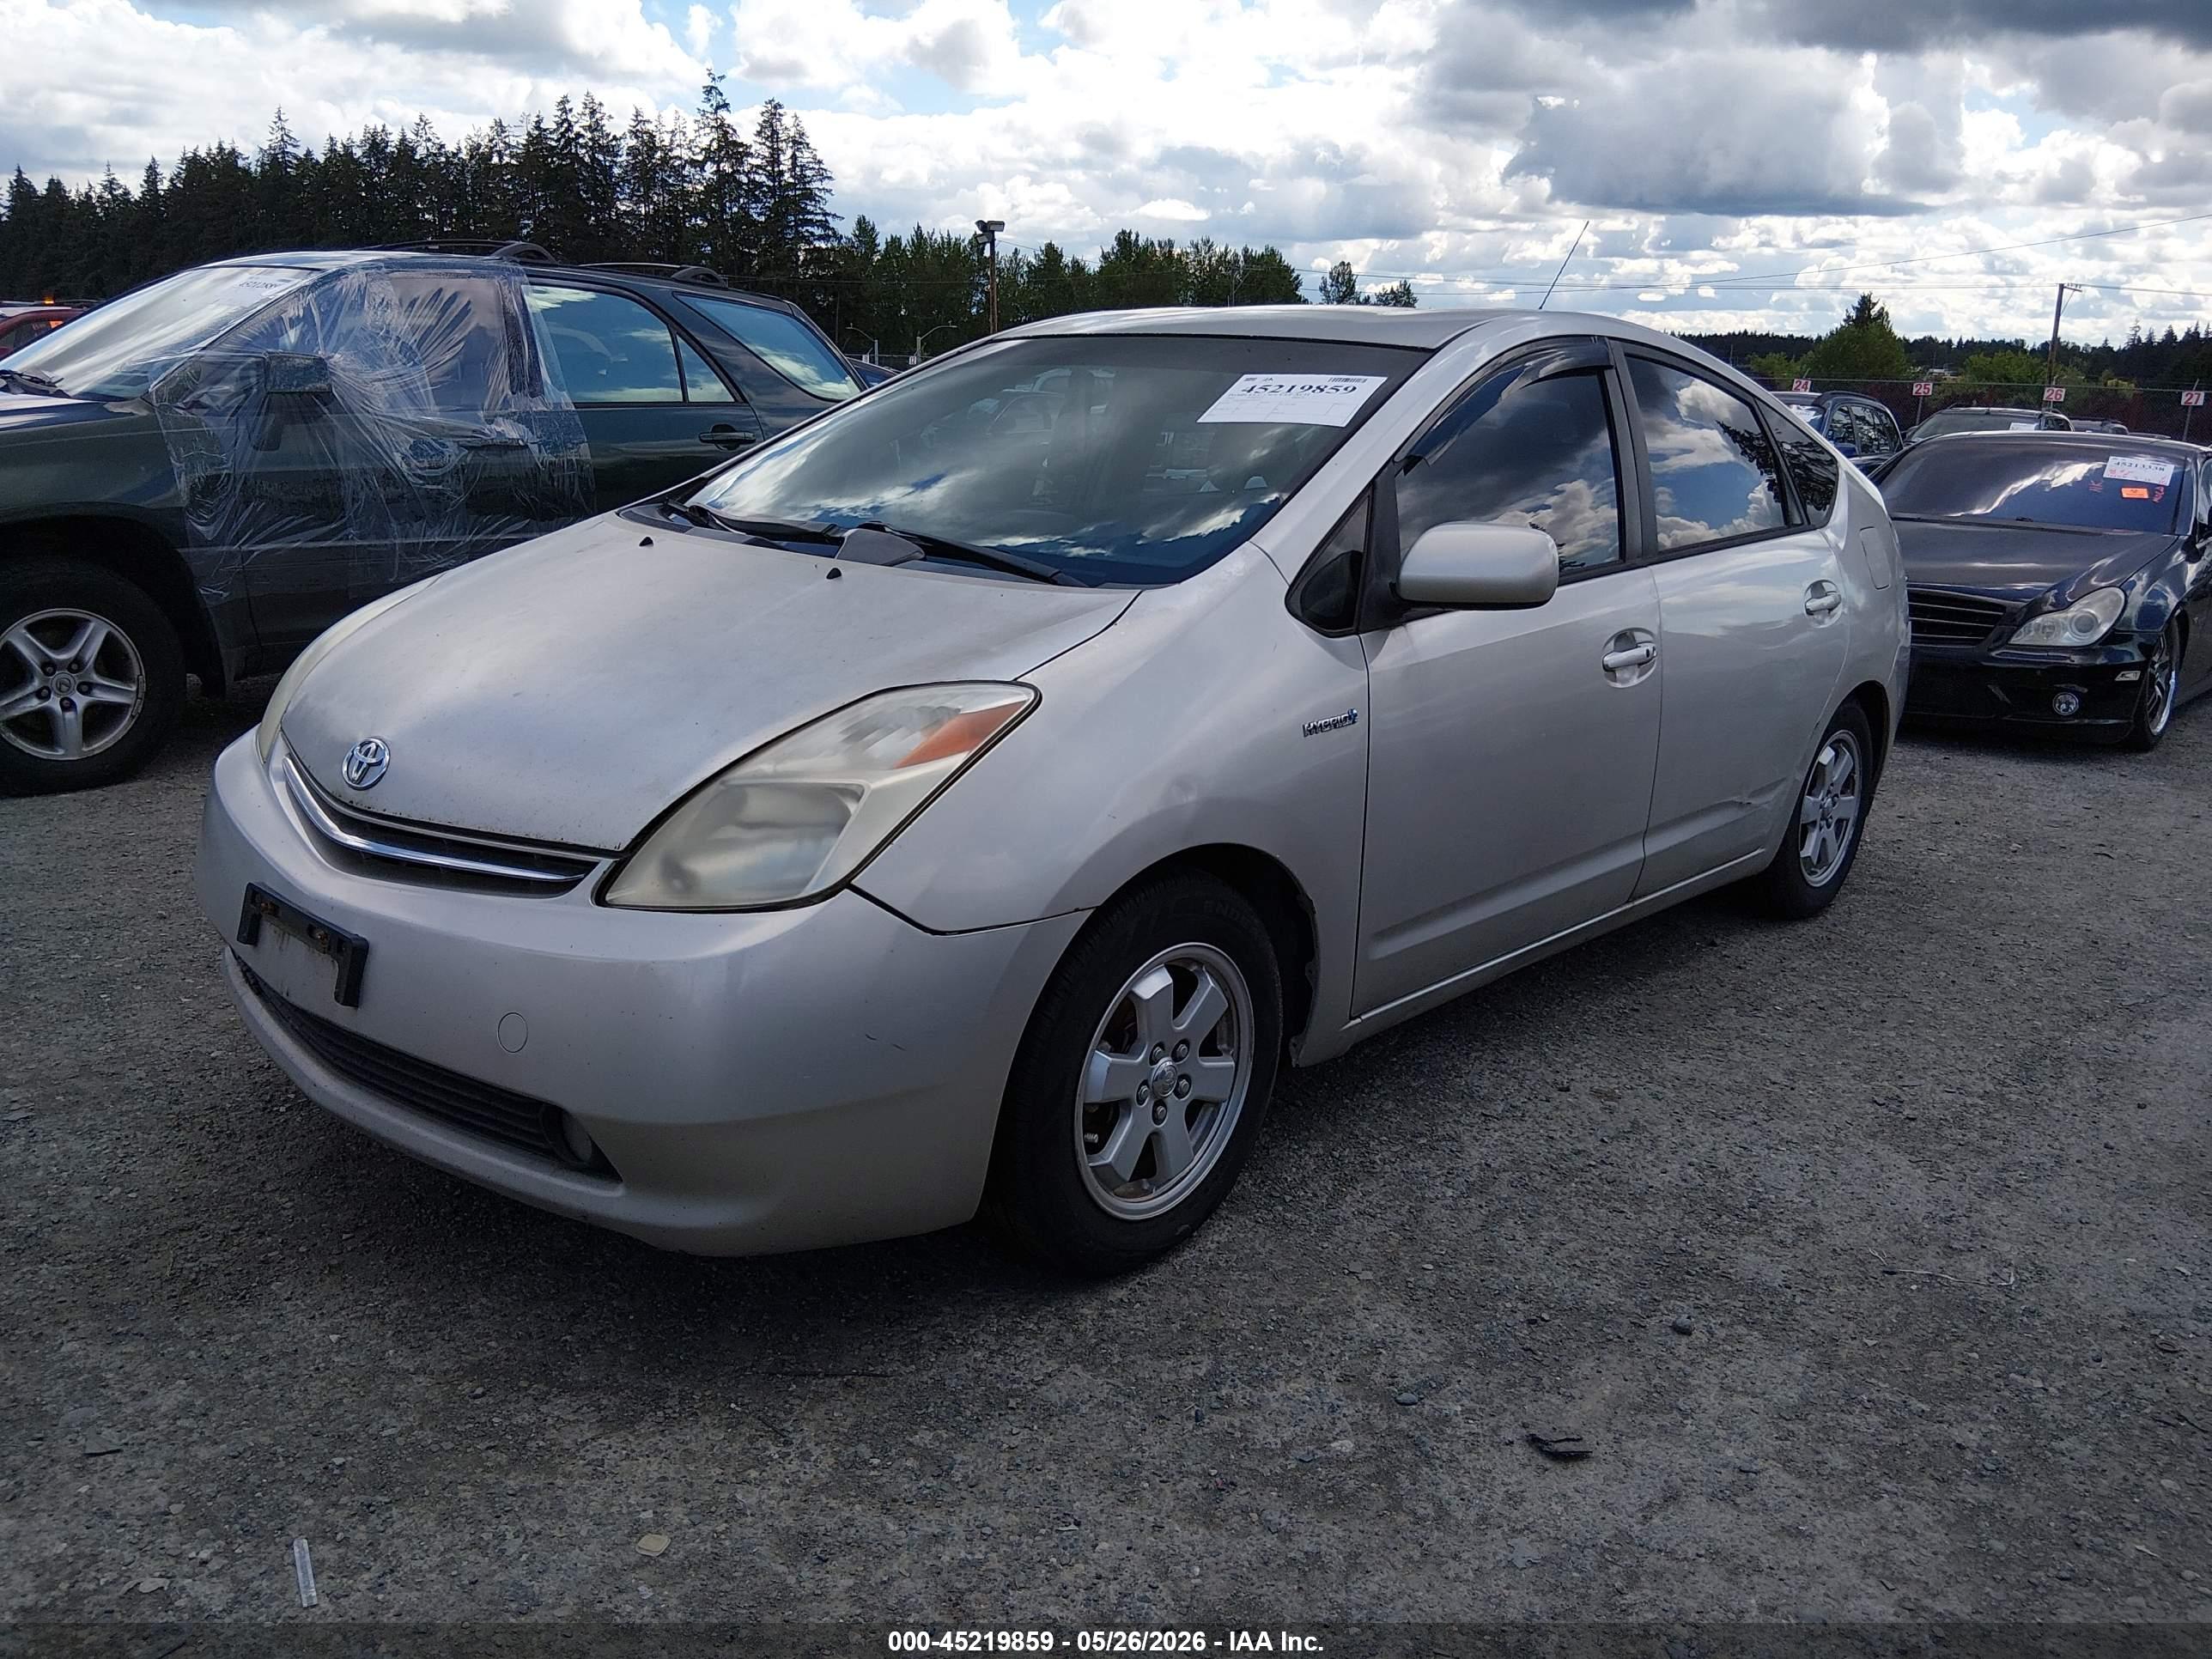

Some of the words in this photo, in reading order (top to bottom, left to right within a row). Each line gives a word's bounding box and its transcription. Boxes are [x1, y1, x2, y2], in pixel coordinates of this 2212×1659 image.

[1241, 384, 1358, 395] 45219859
[1793, 380, 1809, 392] 24
[1914, 383, 1931, 395] 25
[2045, 389, 2063, 401] 26
[2184, 392, 2202, 404] 27
